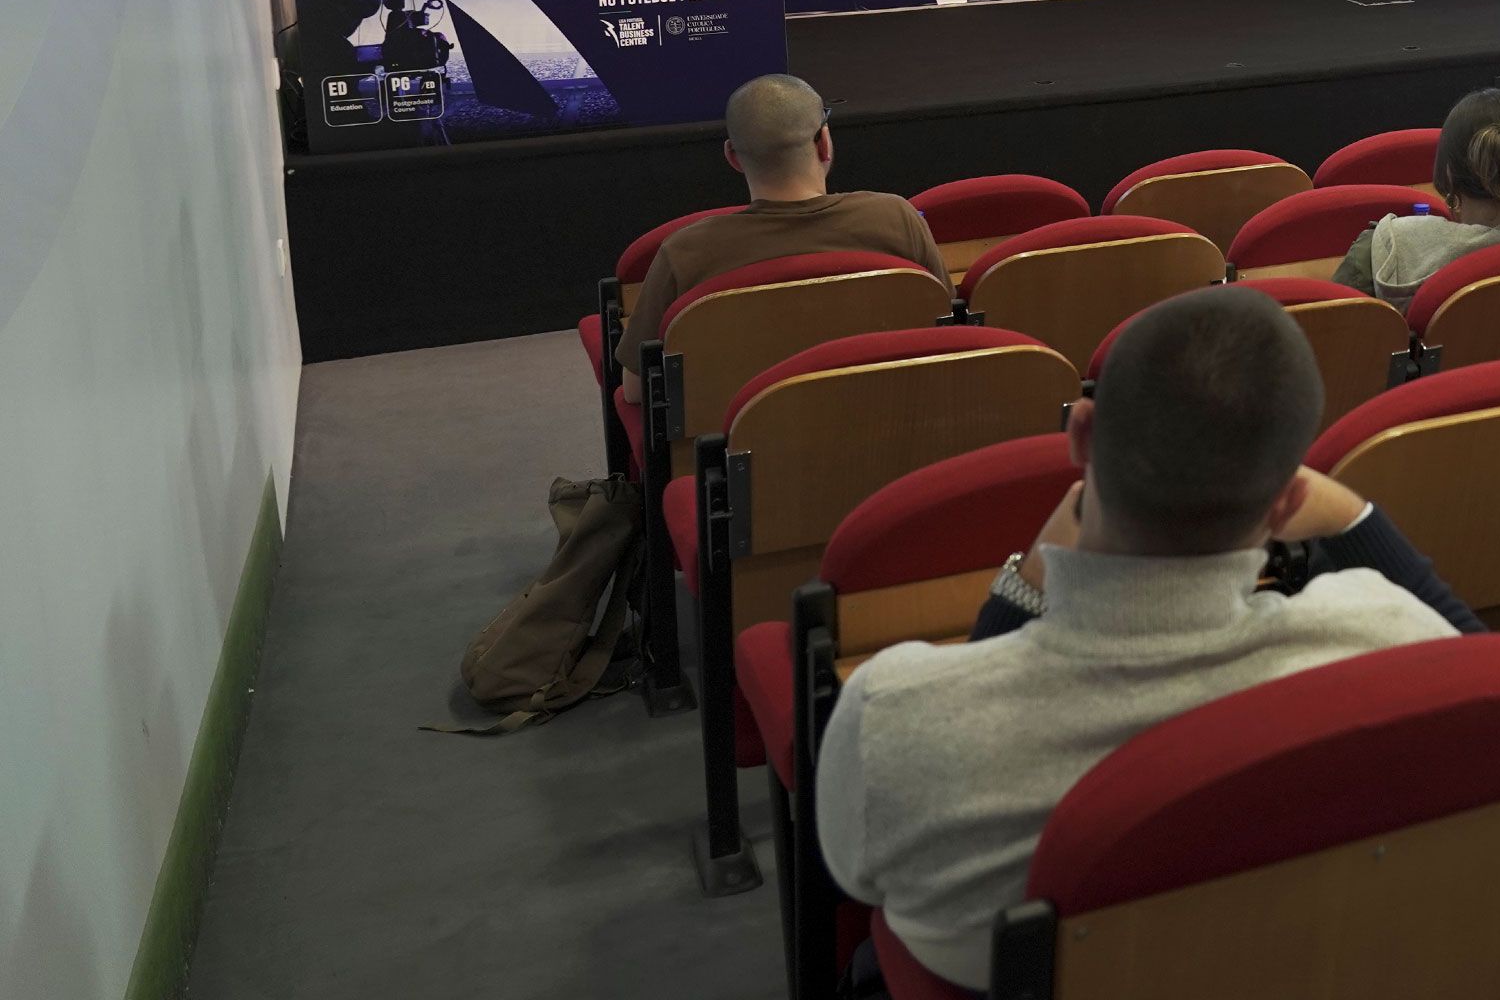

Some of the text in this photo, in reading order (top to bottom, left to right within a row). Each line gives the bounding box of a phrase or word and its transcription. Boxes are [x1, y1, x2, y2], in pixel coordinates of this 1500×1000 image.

[687, 13, 729, 22] UNIVERSIDADE
[620, 22, 645, 31] TALENT
[620, 29, 655, 39] BUSINESS
[620, 37, 648, 47] CENTER
[391, 76, 411, 92] PG
[328, 81, 348, 97] ED
[330, 103, 363, 112] Education
[393, 99, 434, 108] Postgraduate
[394, 106, 417, 114] Course
